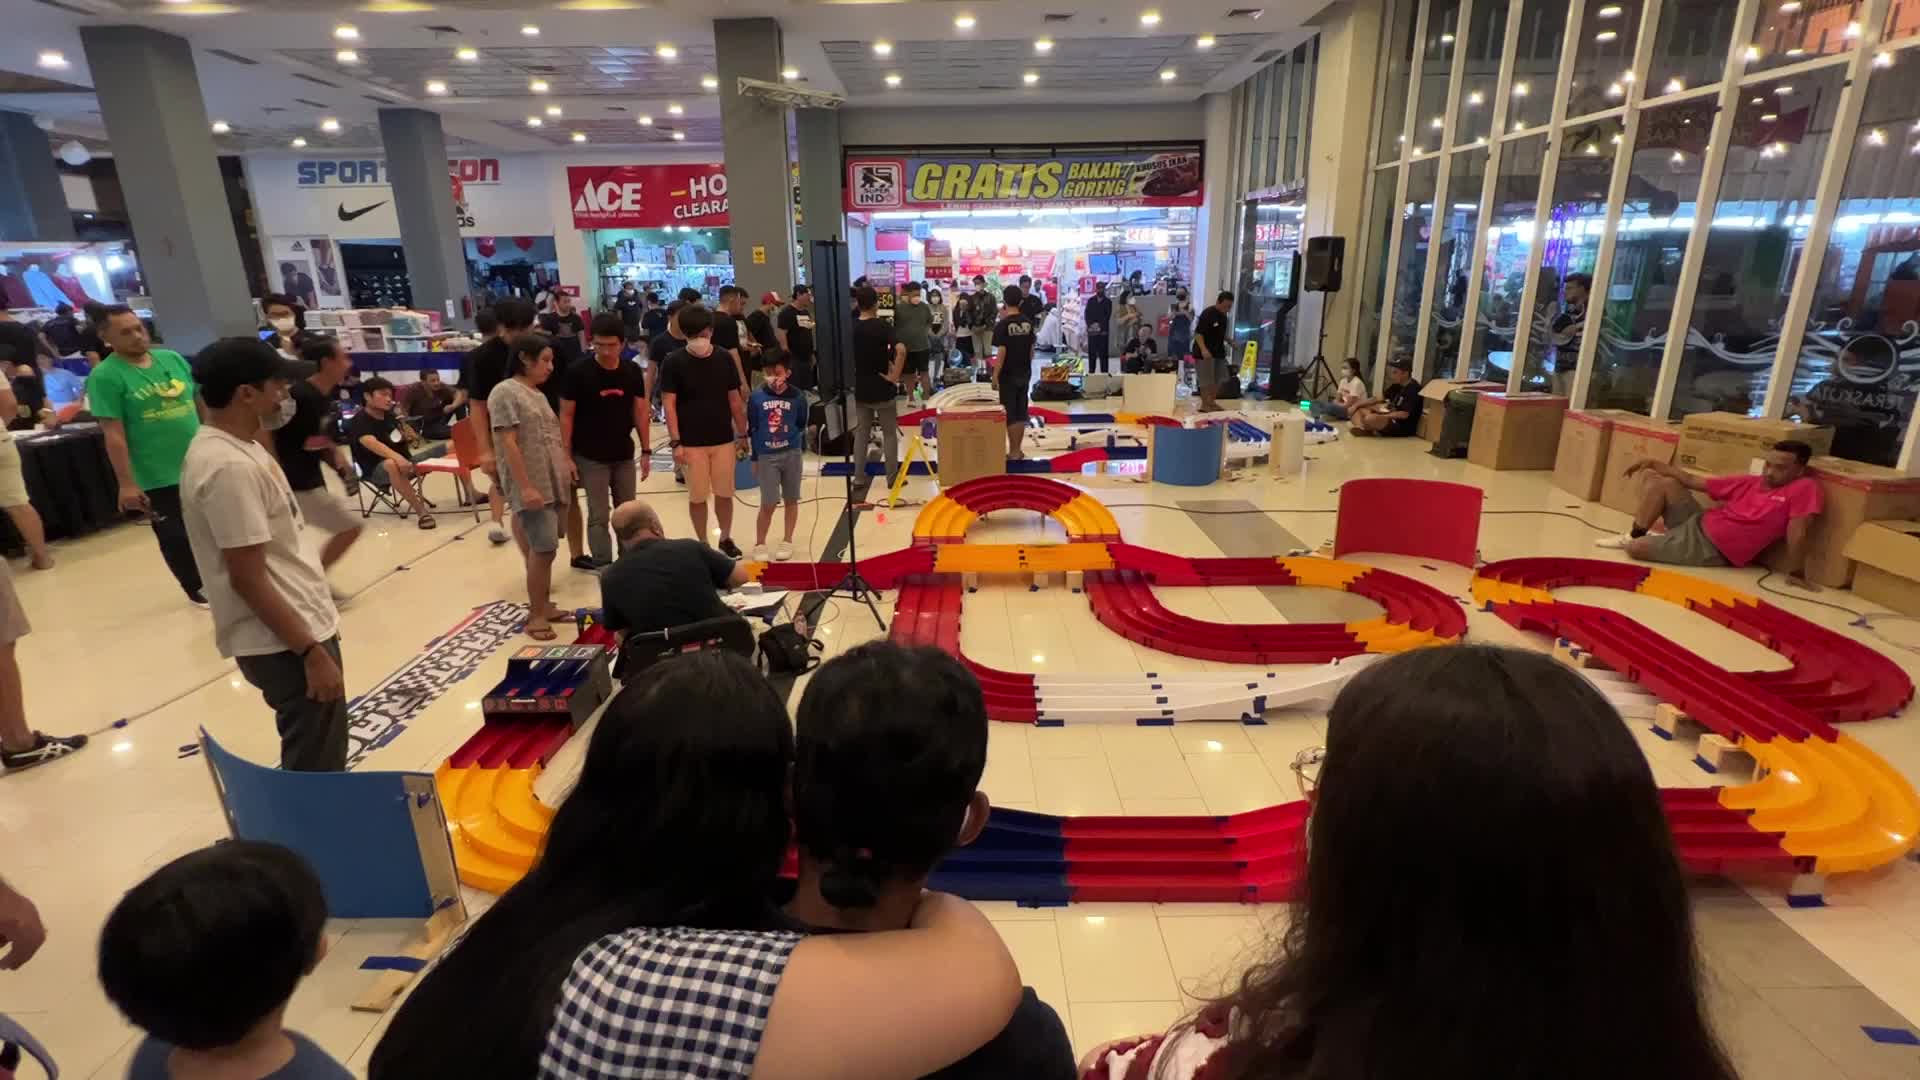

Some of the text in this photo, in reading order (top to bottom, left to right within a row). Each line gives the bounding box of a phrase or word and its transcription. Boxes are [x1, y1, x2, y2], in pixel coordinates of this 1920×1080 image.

[911, 161, 1063, 201] GRATIS
[1063, 179, 1126, 198] GORENG
[574, 178, 642, 212] ACE
[762, 400, 792, 411] SUPER
